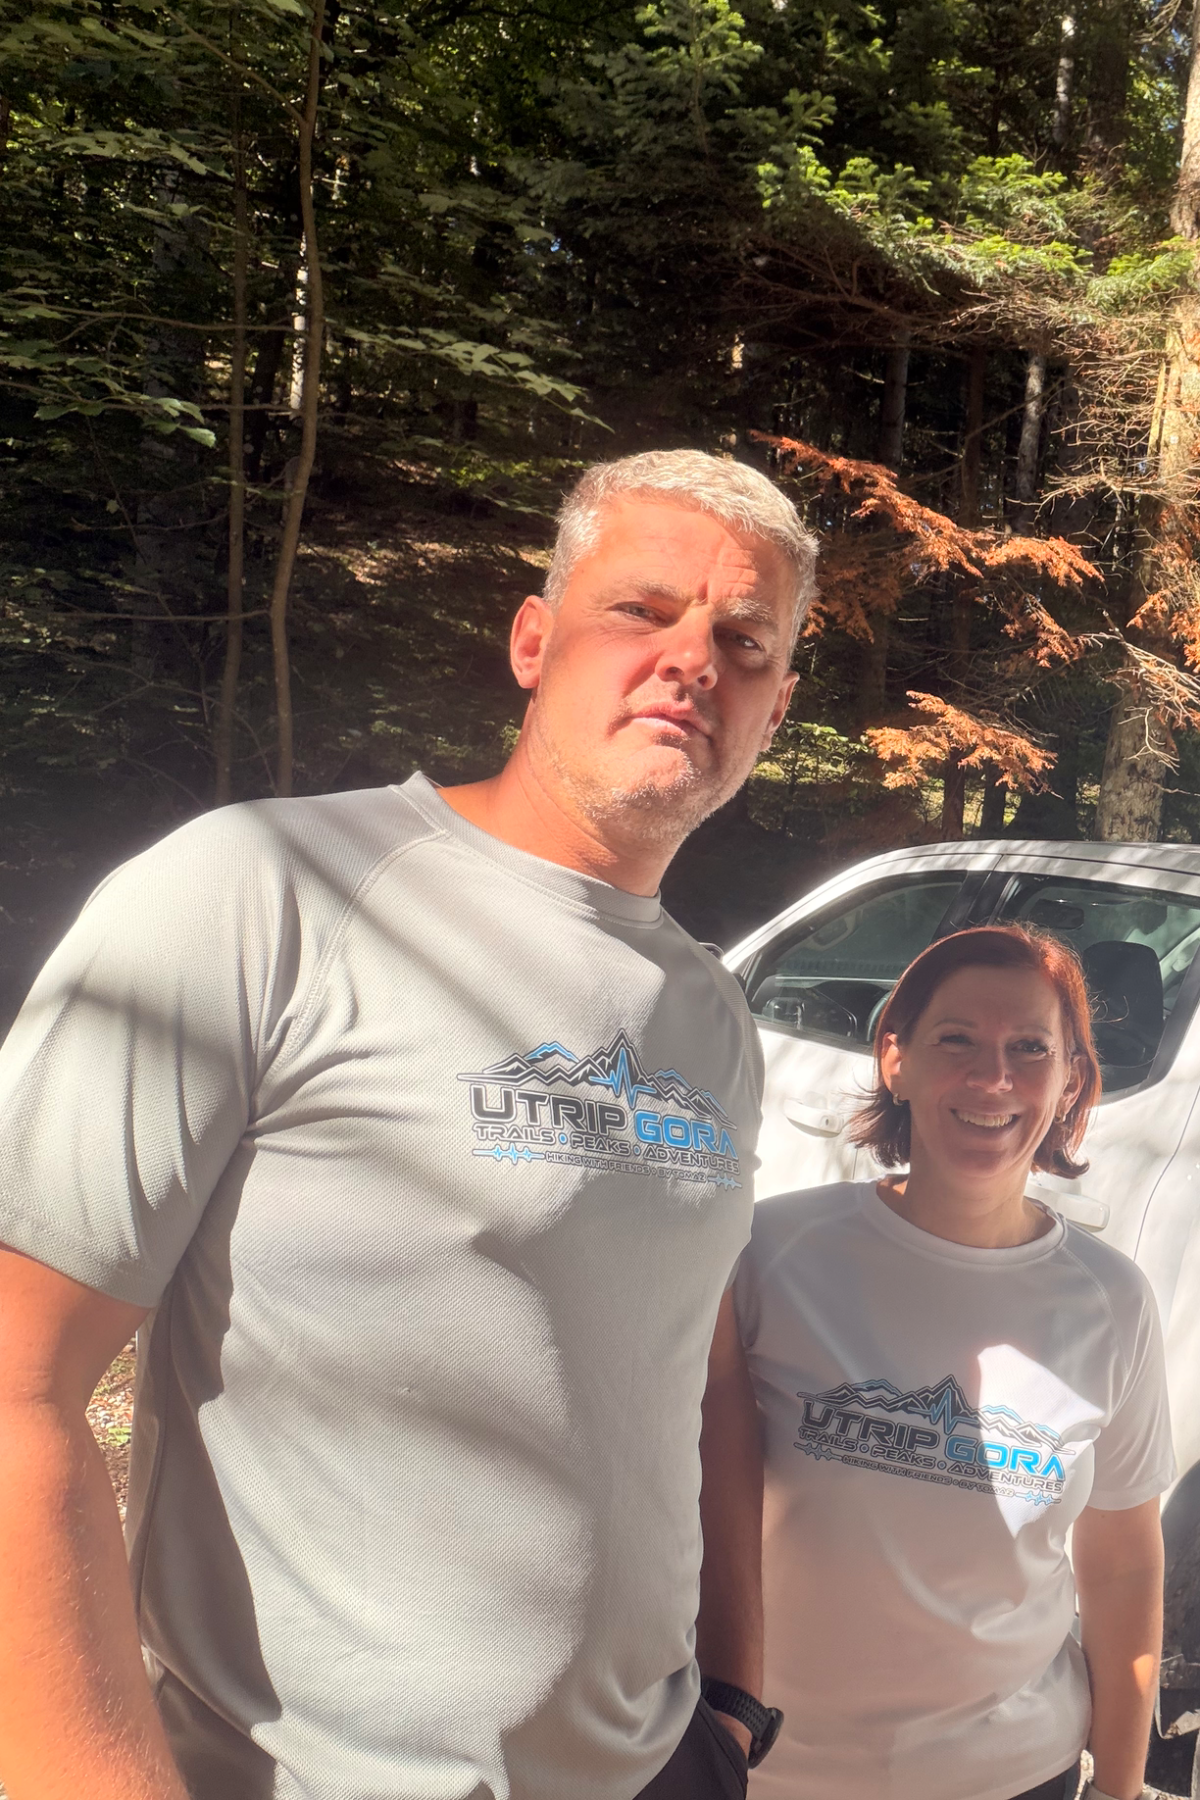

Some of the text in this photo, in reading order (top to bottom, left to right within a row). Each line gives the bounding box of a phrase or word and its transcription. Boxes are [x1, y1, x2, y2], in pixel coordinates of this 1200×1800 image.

[469, 1083, 738, 1159] UTRIP GORA
[472, 1123, 740, 1174] TRAILS PEAKS ADVENTURES
[546, 1151, 581, 1165] HIKING
[582, 1156, 608, 1169] WITH
[608, 1160, 650, 1175] FRIENDS
[657, 1166, 672, 1177] BY
[798, 1427, 1065, 1495] TRAILS PEAKS ADVENTURES
[802, 1400, 1066, 1481] UTRIP GORA
[842, 1455, 878, 1470] HIKING
[879, 1463, 907, 1477] WITH
[907, 1469, 952, 1486] FRIENDS
[959, 1479, 976, 1490] BY
